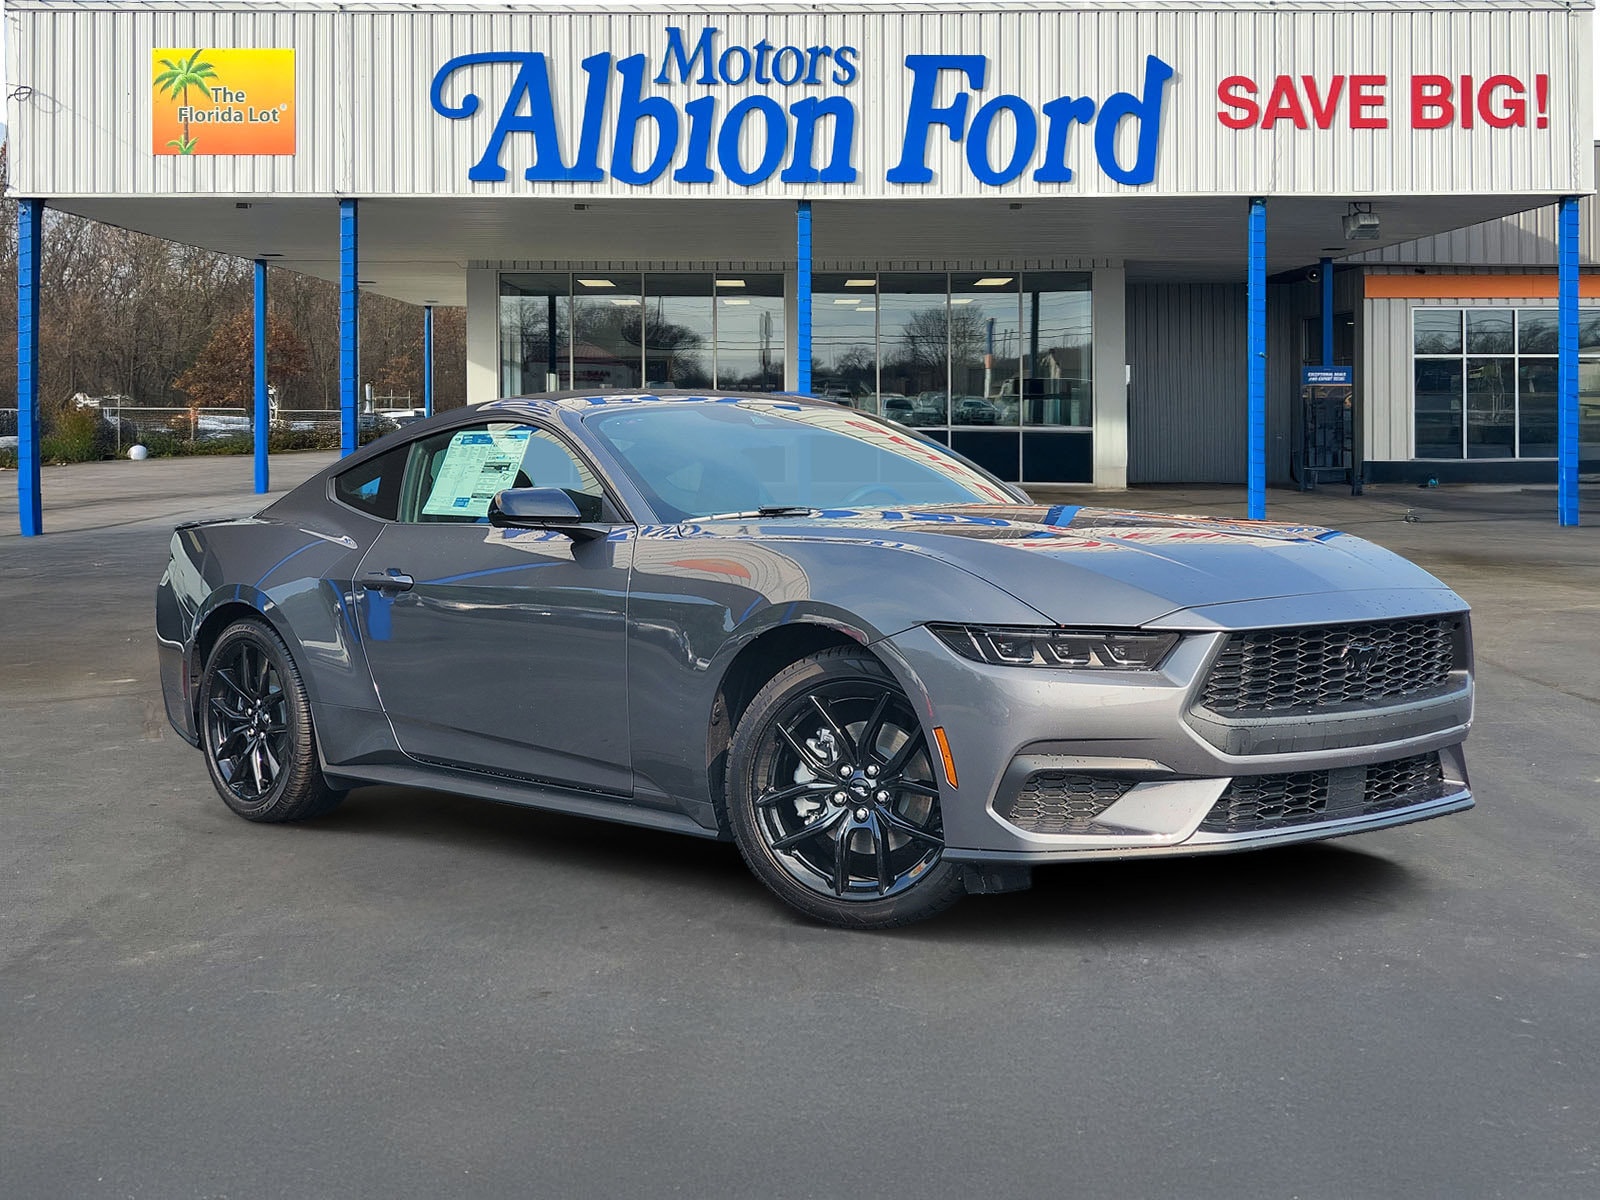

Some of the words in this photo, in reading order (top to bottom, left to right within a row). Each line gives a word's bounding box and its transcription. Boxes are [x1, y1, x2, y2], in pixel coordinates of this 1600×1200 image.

[654, 26, 857, 86] Motors
[178, 106, 244, 122] Florida
[210, 86, 246, 103] The
[429, 51, 858, 187] Albion
[885, 54, 1175, 186] Ford
[1217, 74, 1388, 129] SAVE
[1411, 74, 1549, 129] BIG!
